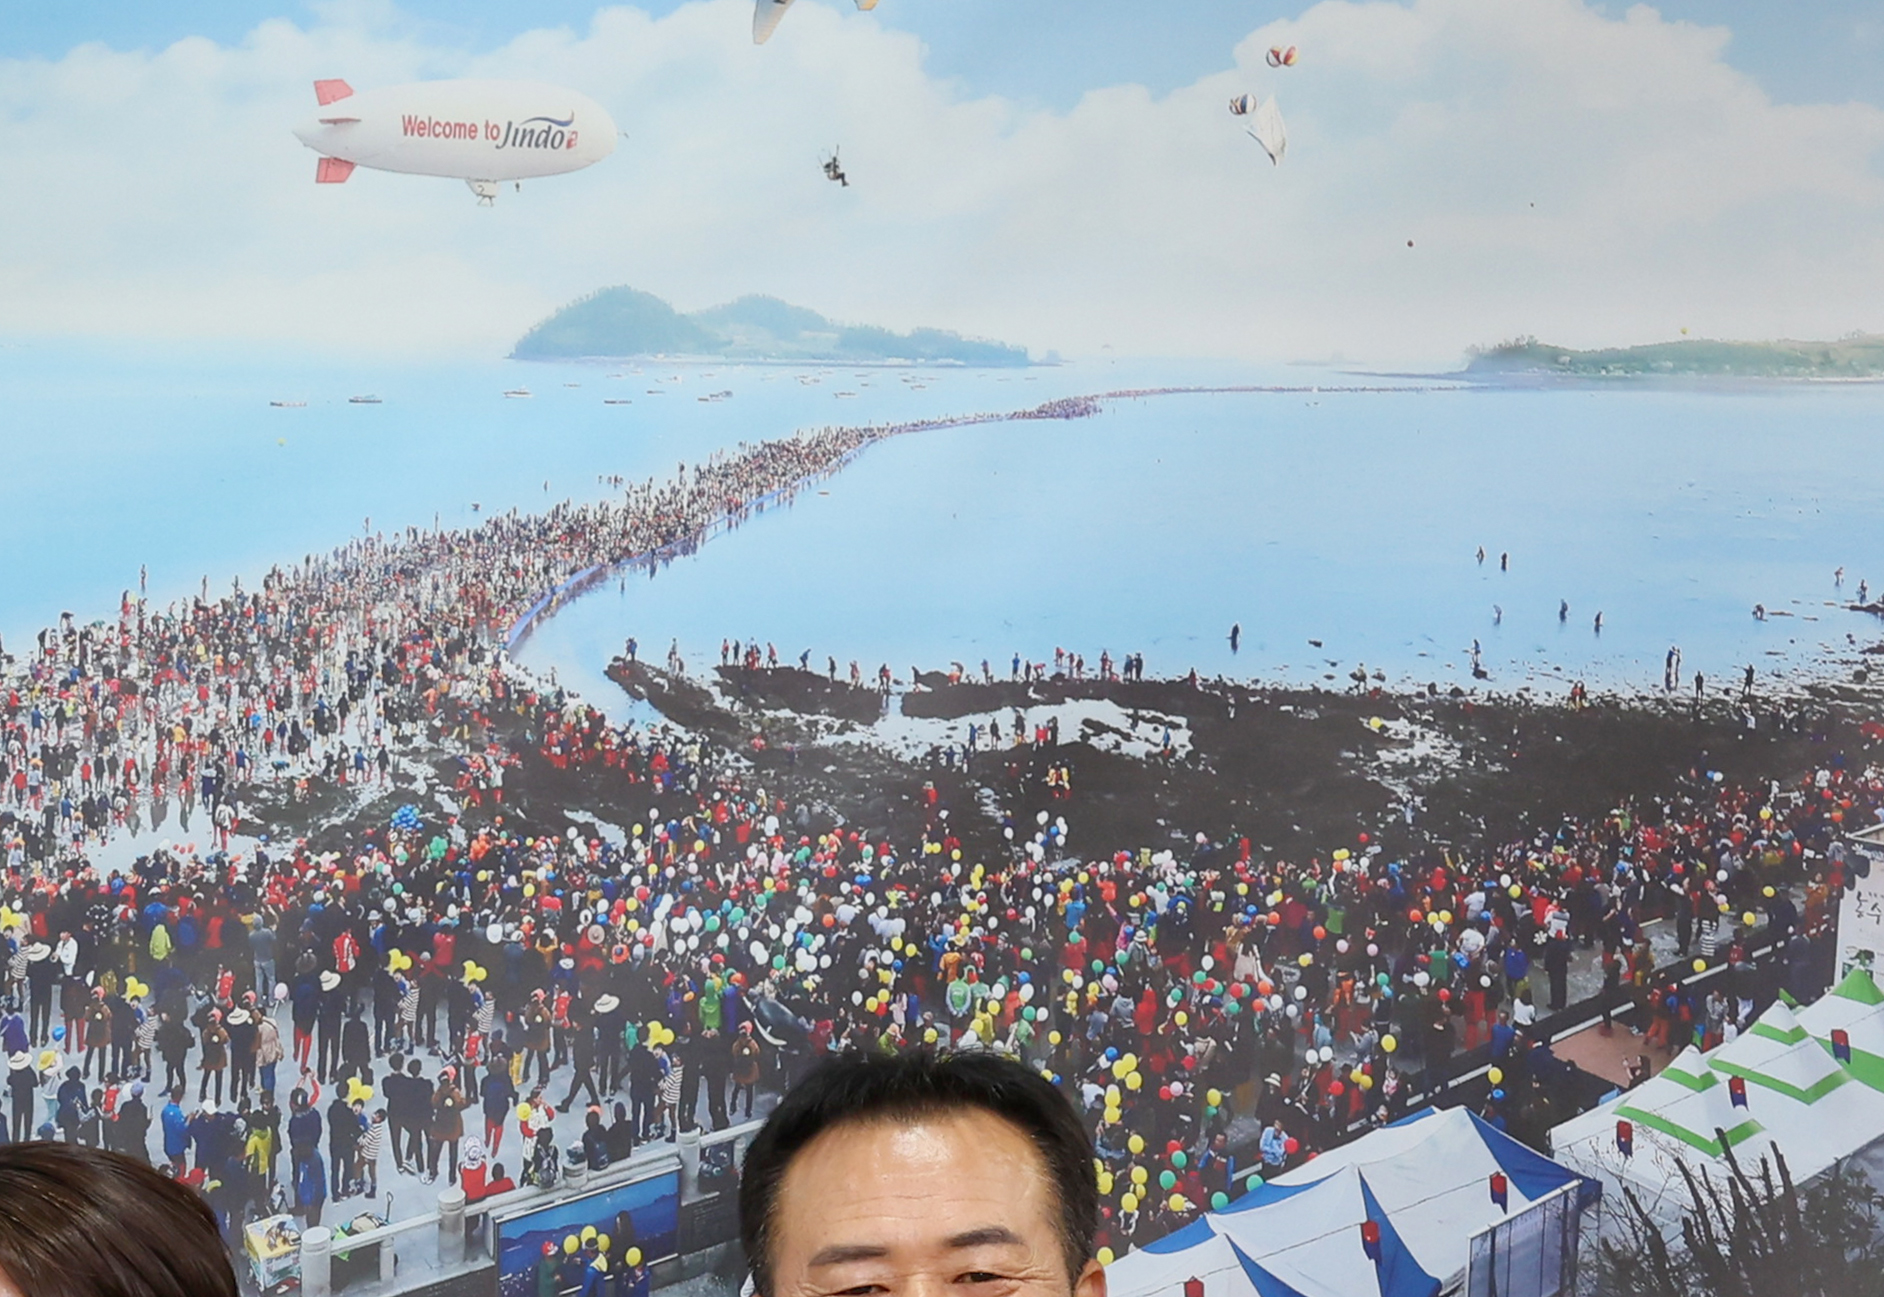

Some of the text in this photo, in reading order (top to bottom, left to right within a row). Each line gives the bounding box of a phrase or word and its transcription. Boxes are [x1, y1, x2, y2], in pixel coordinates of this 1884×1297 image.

[402, 114, 478, 142] Welcome
[484, 119, 501, 141] to
[495, 119, 565, 150] Jindo
